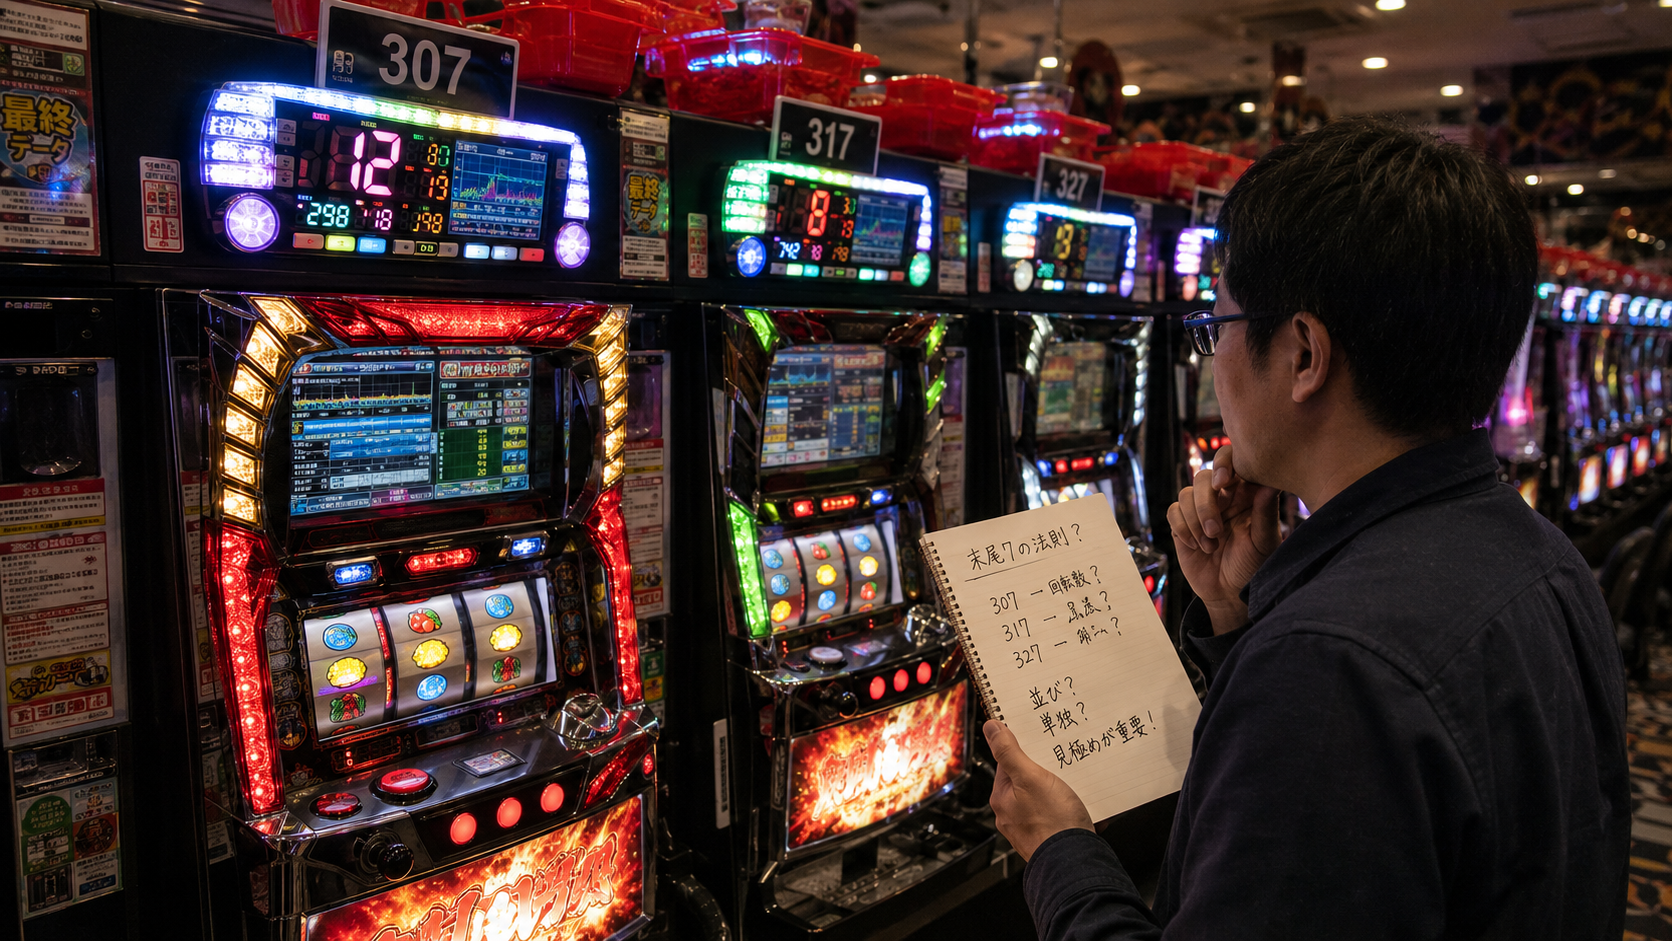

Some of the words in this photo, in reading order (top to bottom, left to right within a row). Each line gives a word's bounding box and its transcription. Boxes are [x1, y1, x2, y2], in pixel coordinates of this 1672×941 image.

[379, 32, 471, 95] 307
[2, 95, 73, 137] 最終
[10, 134, 70, 162] データ
[806, 117, 855, 160] 317
[350, 130, 402, 196] 12
[1056, 168, 1089, 201] 327
[306, 202, 349, 228] 298
[989, 591, 1019, 615] 307
[1001, 617, 1031, 642] 317
[1012, 643, 1043, 669] 327
